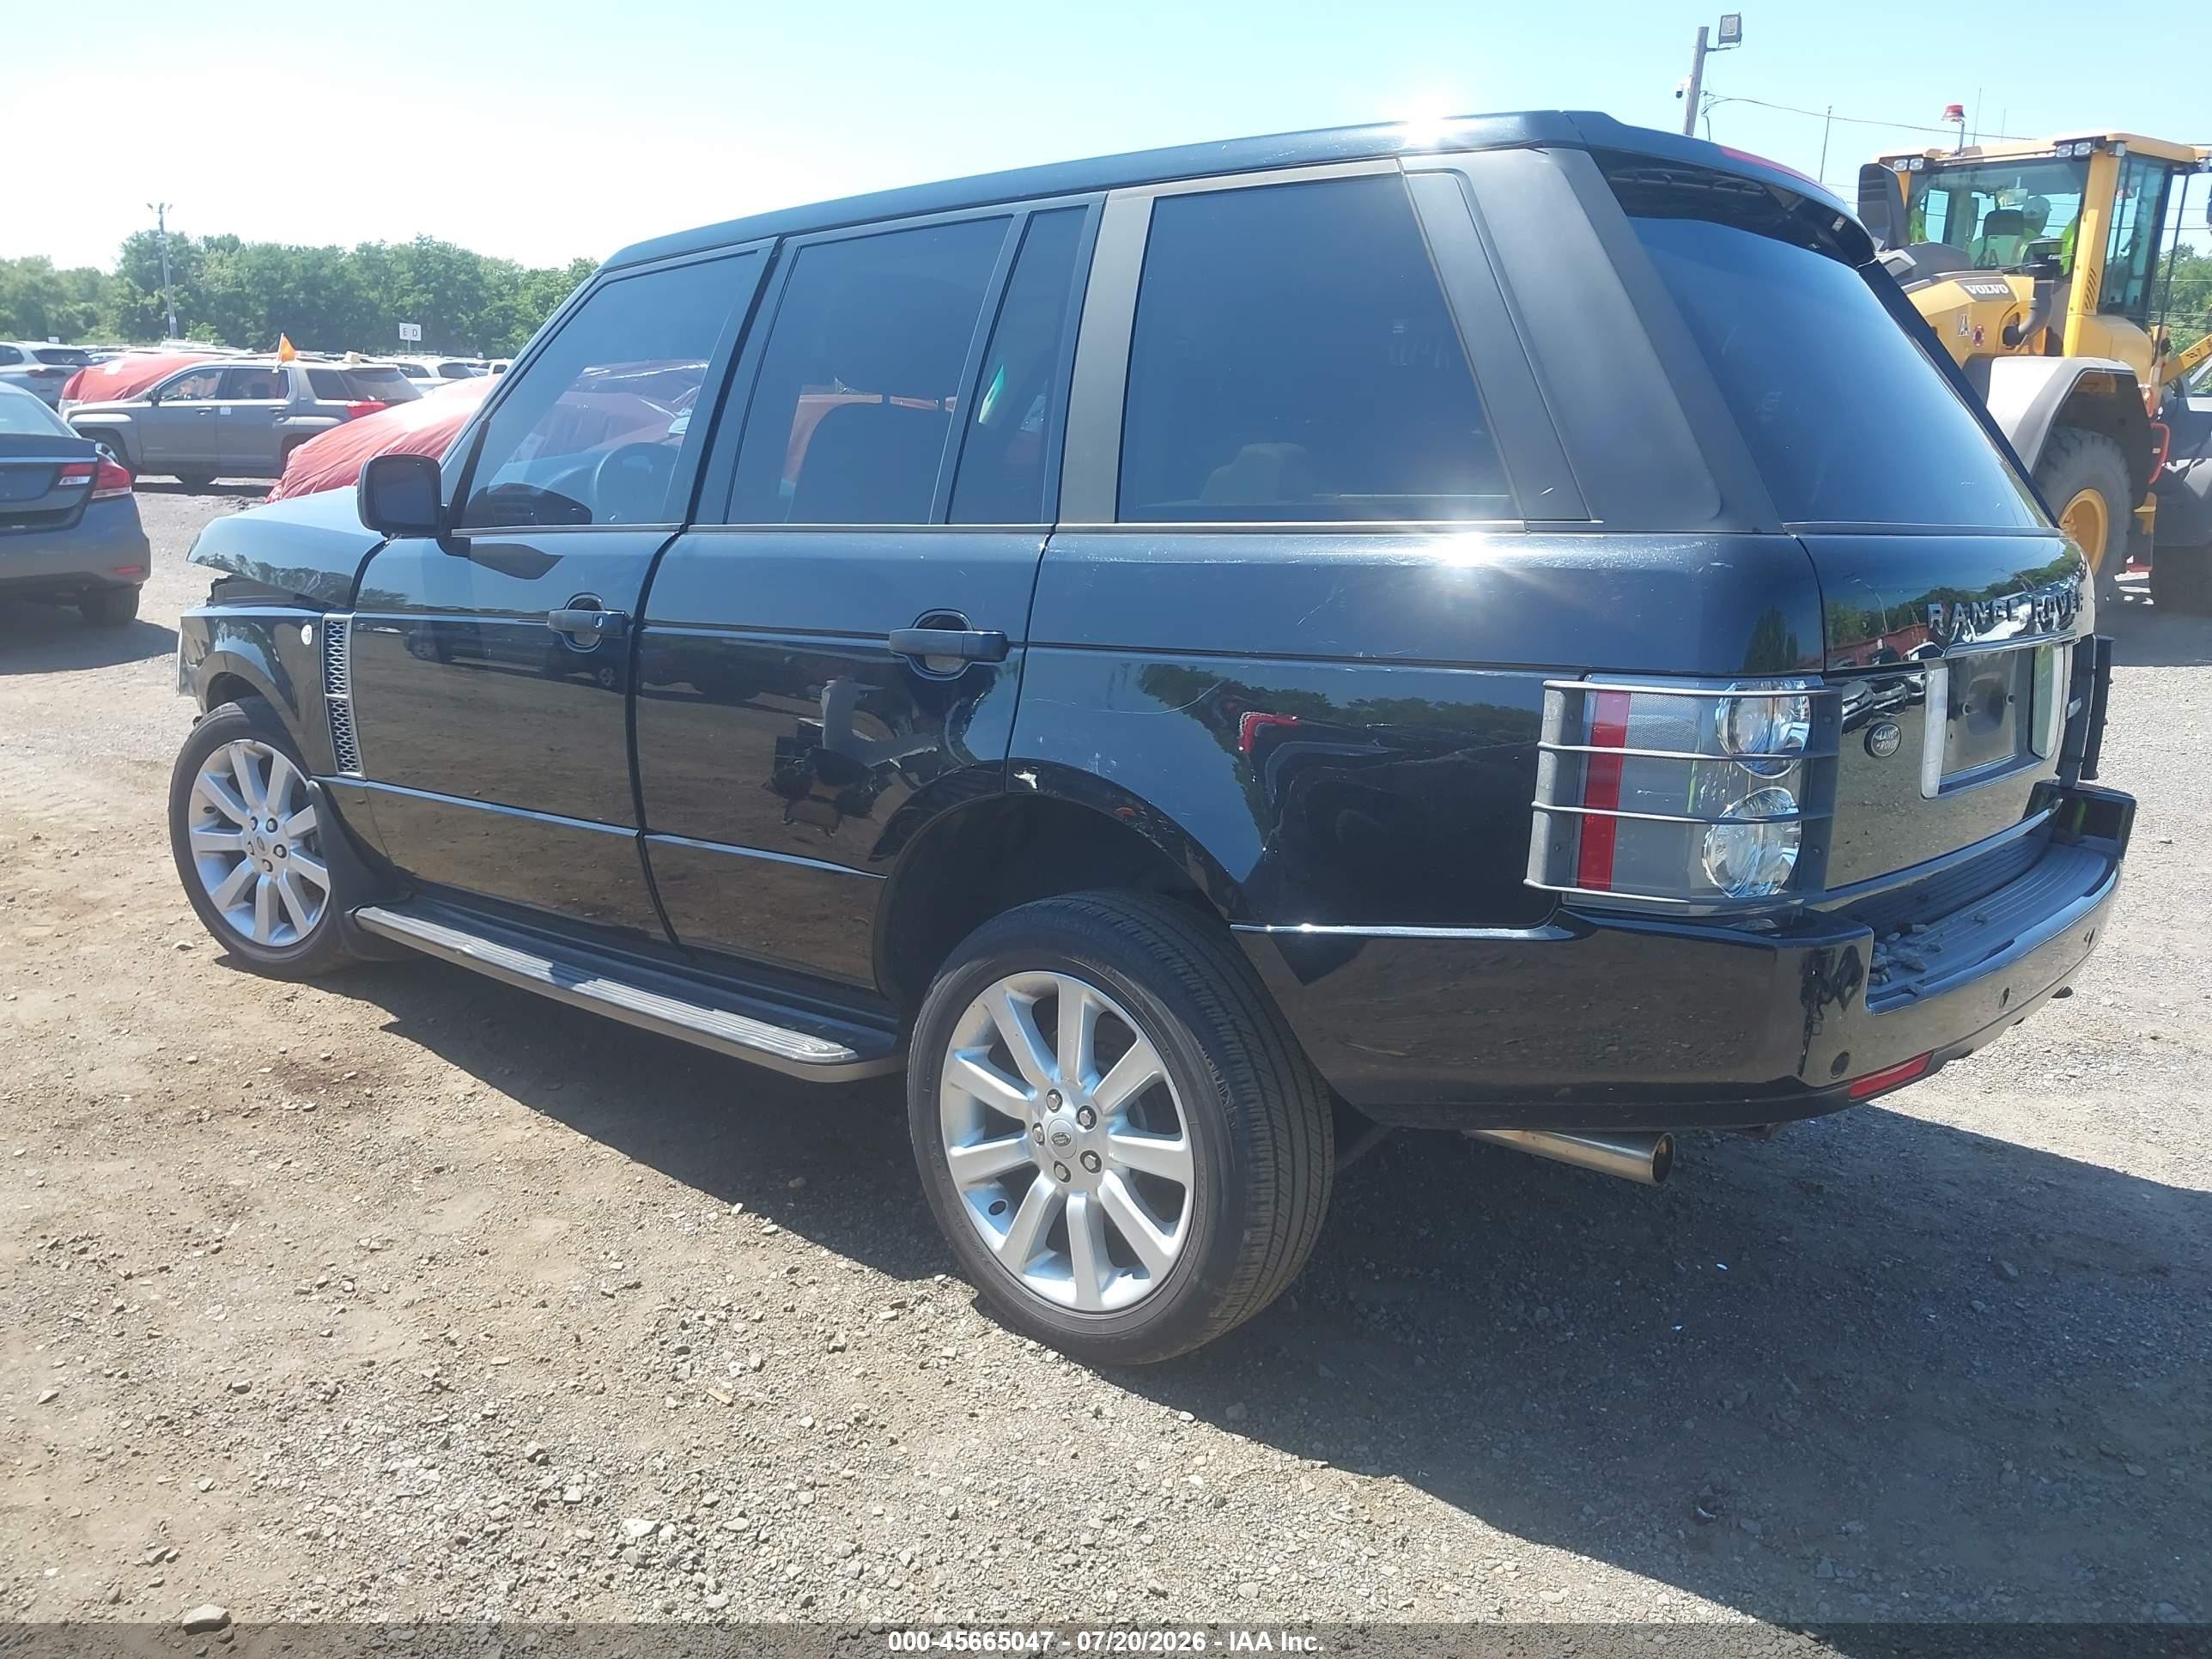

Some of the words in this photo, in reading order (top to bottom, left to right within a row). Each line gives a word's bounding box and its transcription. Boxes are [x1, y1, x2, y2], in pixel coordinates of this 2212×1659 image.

[1964, 283, 2009, 295] VOLVO
[412, 328, 418, 337] D
[1927, 598, 2021, 630] RANGE
